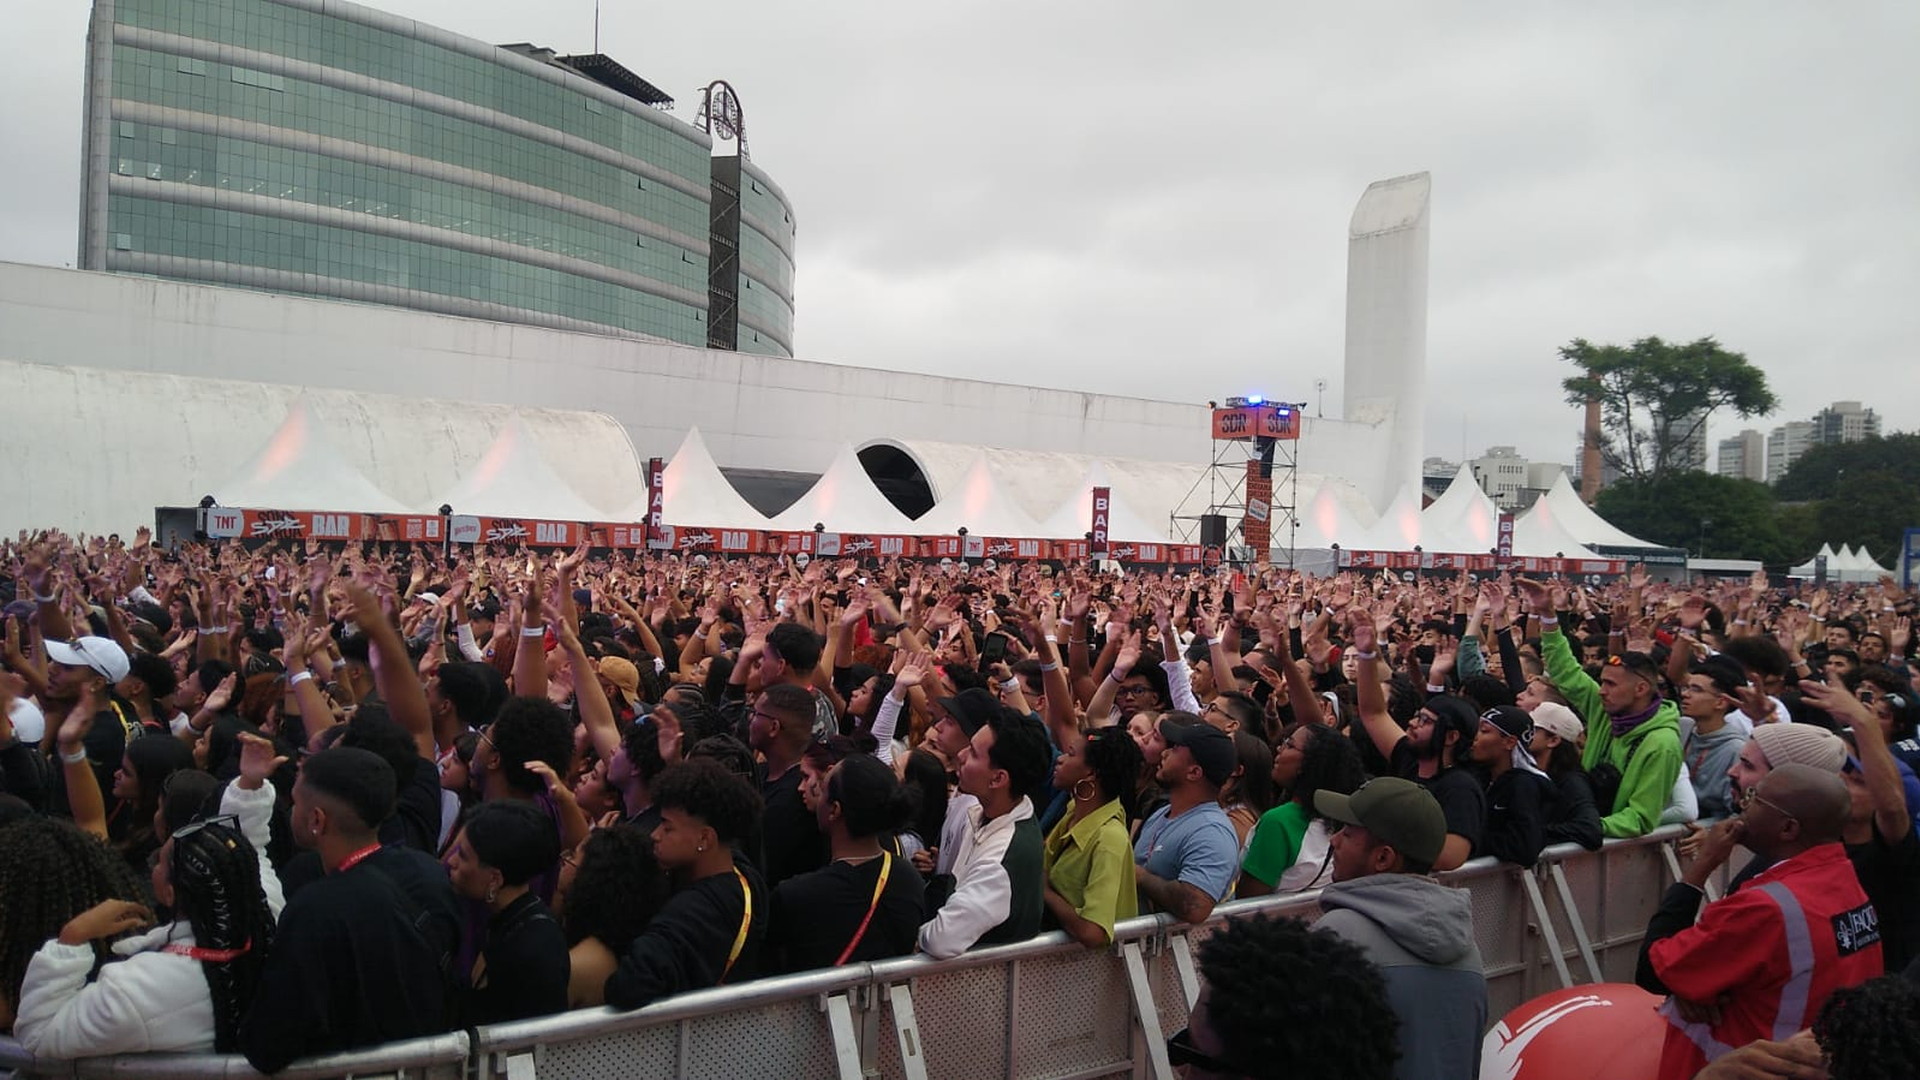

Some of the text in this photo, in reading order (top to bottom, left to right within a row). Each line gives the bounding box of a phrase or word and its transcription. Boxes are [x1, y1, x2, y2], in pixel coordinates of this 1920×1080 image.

[1222, 413, 1247, 433] SDR
[1267, 413, 1292, 434] SDR
[652, 471, 663, 527] BAR
[214, 515, 236, 529] TNT
[312, 514, 350, 537] BAR
[1094, 498, 1108, 543] BAR
[535, 523, 568, 544] BAR
[721, 531, 749, 550] BAR
[1500, 521, 1512, 557] BAR
[881, 537, 904, 554] BAR
[1018, 539, 1039, 557] BAR
